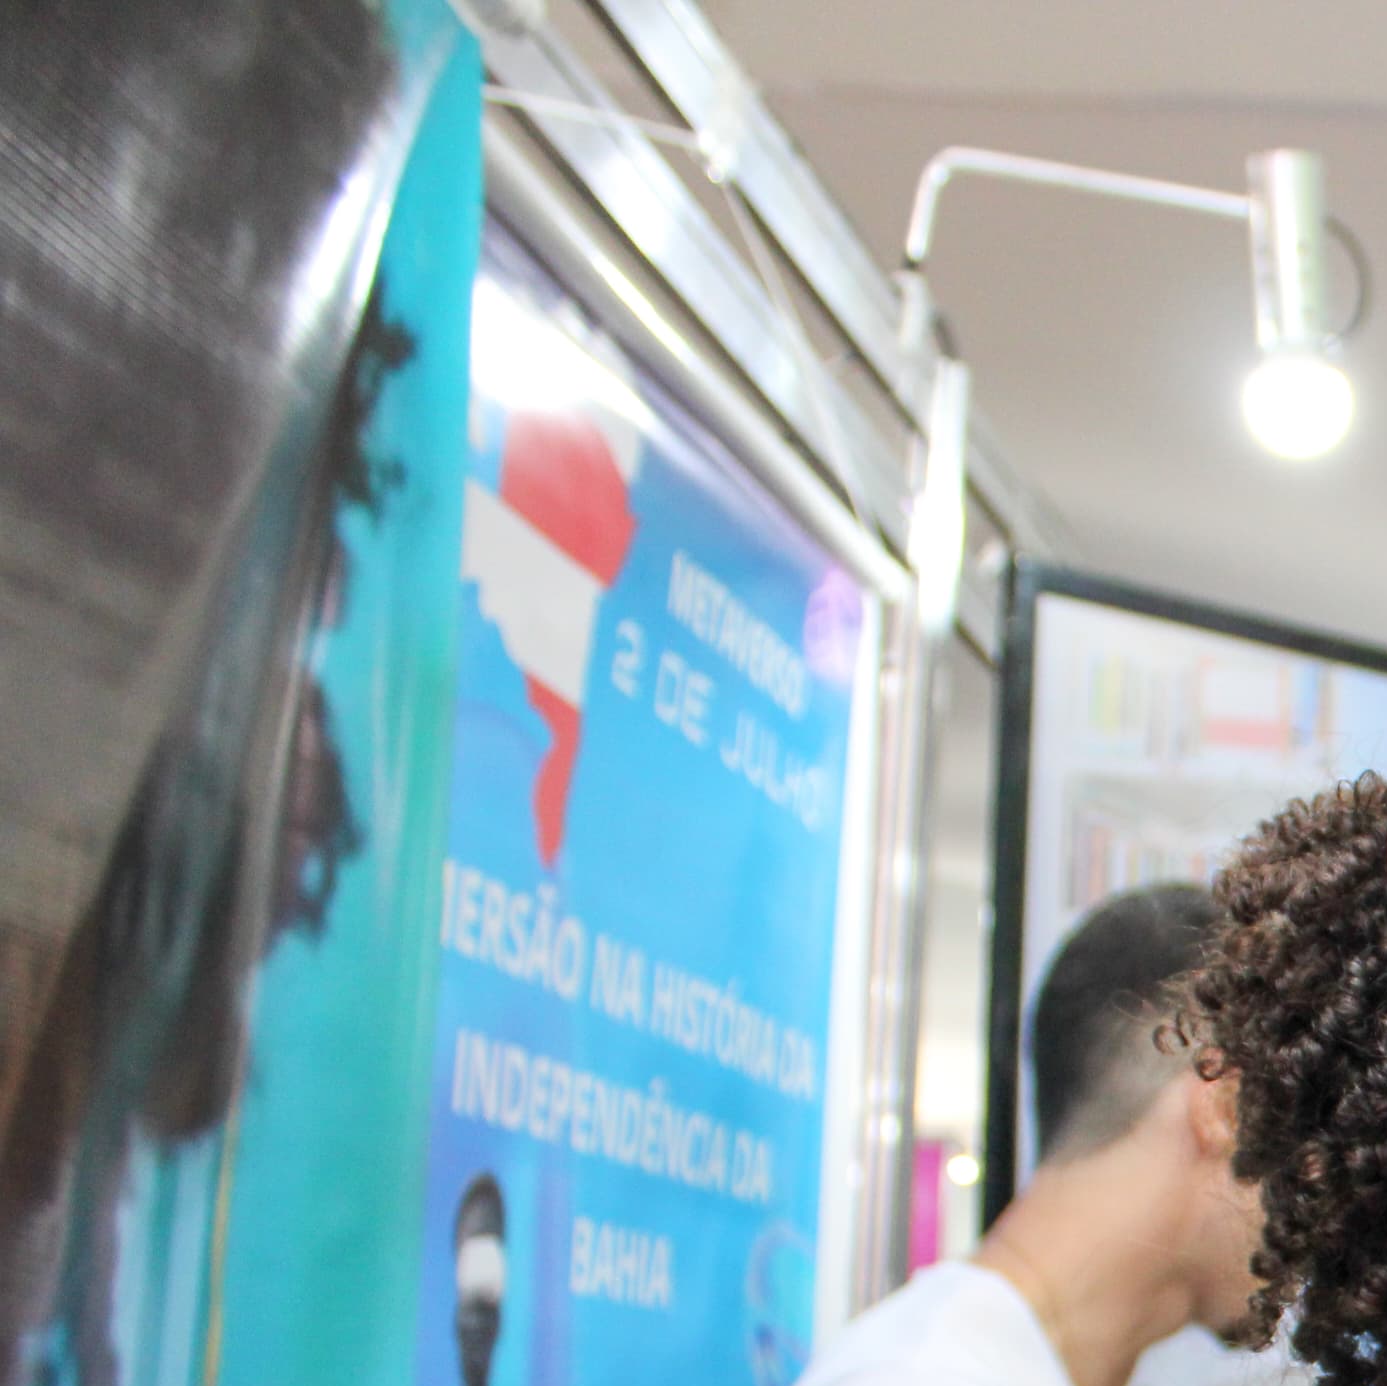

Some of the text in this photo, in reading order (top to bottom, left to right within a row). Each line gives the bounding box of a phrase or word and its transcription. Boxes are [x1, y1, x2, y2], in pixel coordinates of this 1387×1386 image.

[667, 549, 807, 722] METAVERSO
[611, 616, 825, 834] 2 DE JULHO
[589, 932, 647, 1029] NA
[650, 960, 777, 1086] HISTÓRIA
[777, 1024, 816, 1100] DA
[452, 1028, 772, 1203] INDEPENDÊNCIA DA
[569, 1215, 672, 1308] BAHIA
